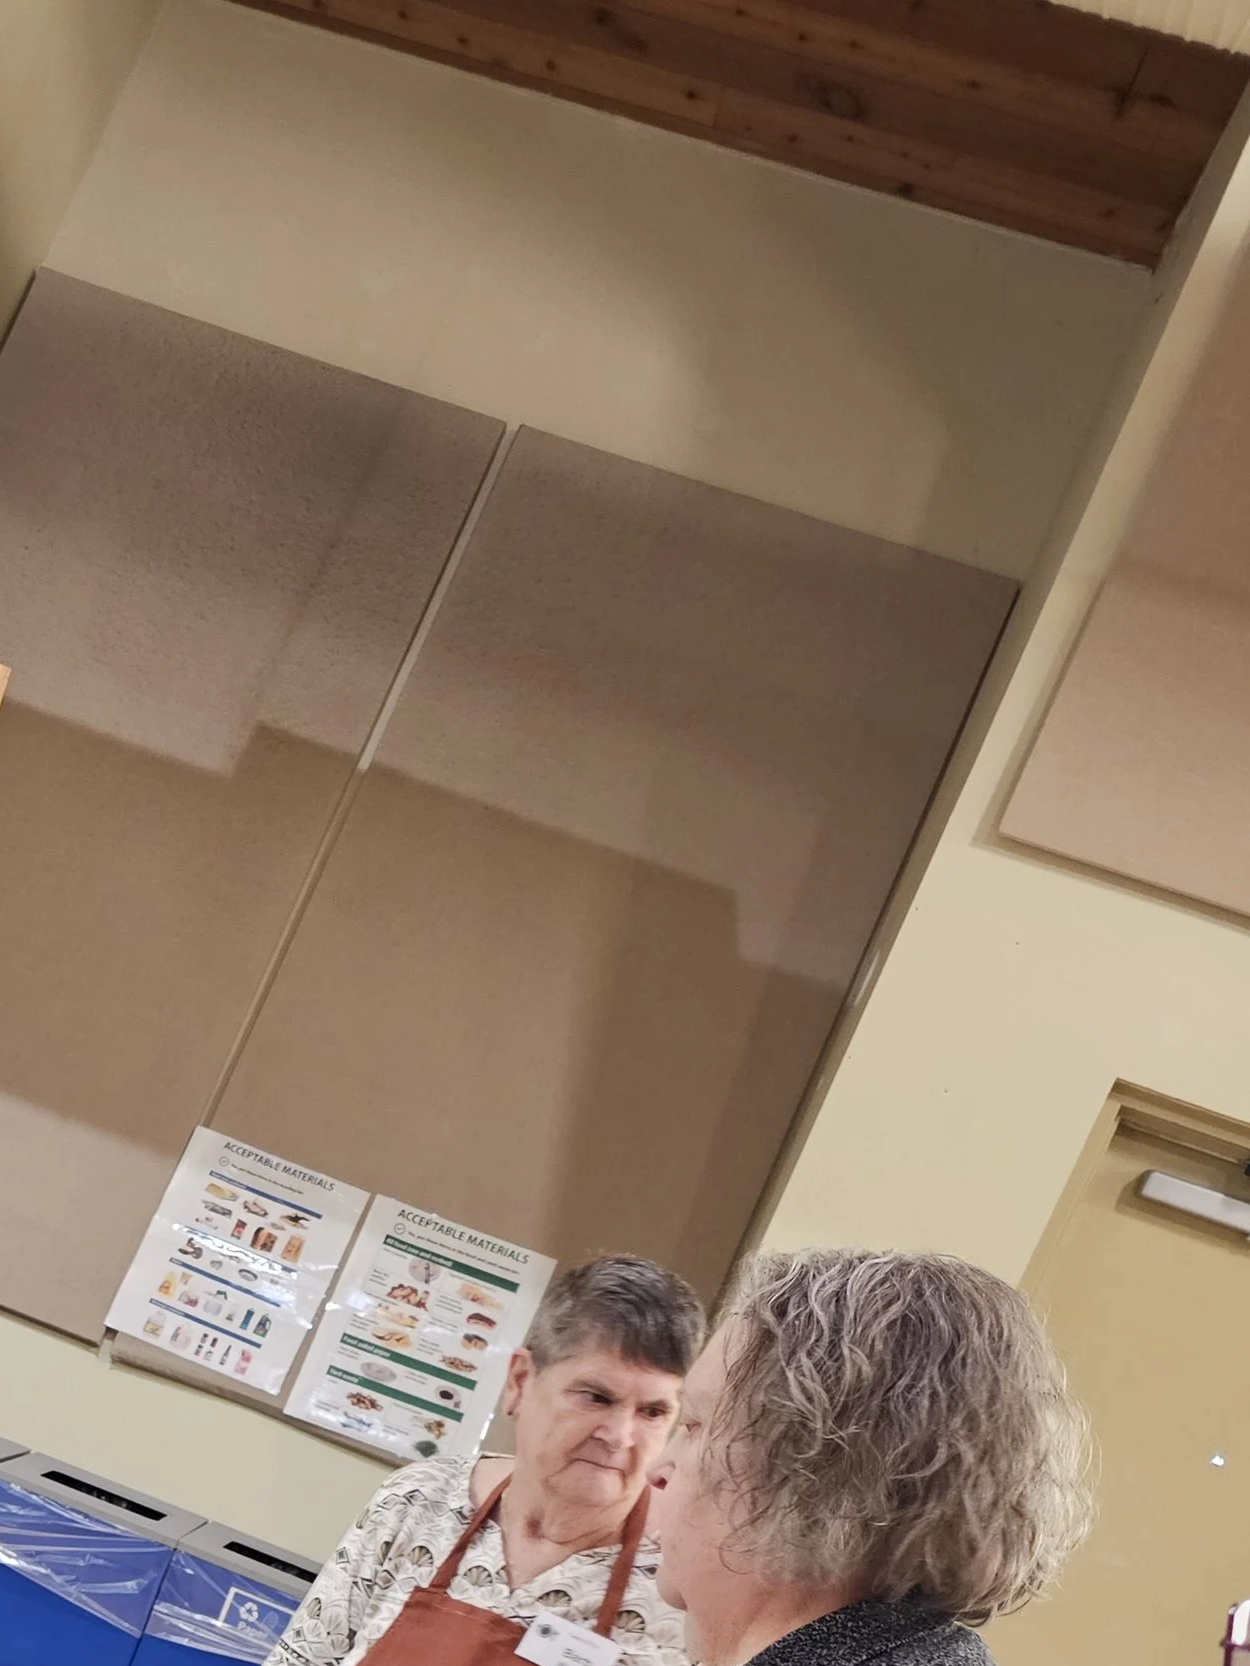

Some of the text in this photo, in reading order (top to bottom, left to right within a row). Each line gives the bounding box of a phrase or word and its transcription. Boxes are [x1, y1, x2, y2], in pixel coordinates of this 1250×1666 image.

[223, 1142, 282, 1171] ACCEPTABLE
[281, 1165, 336, 1191] MATERIALS
[397, 1209, 467, 1241] ACCEPTABLE
[466, 1234, 530, 1264] MATERIALS
